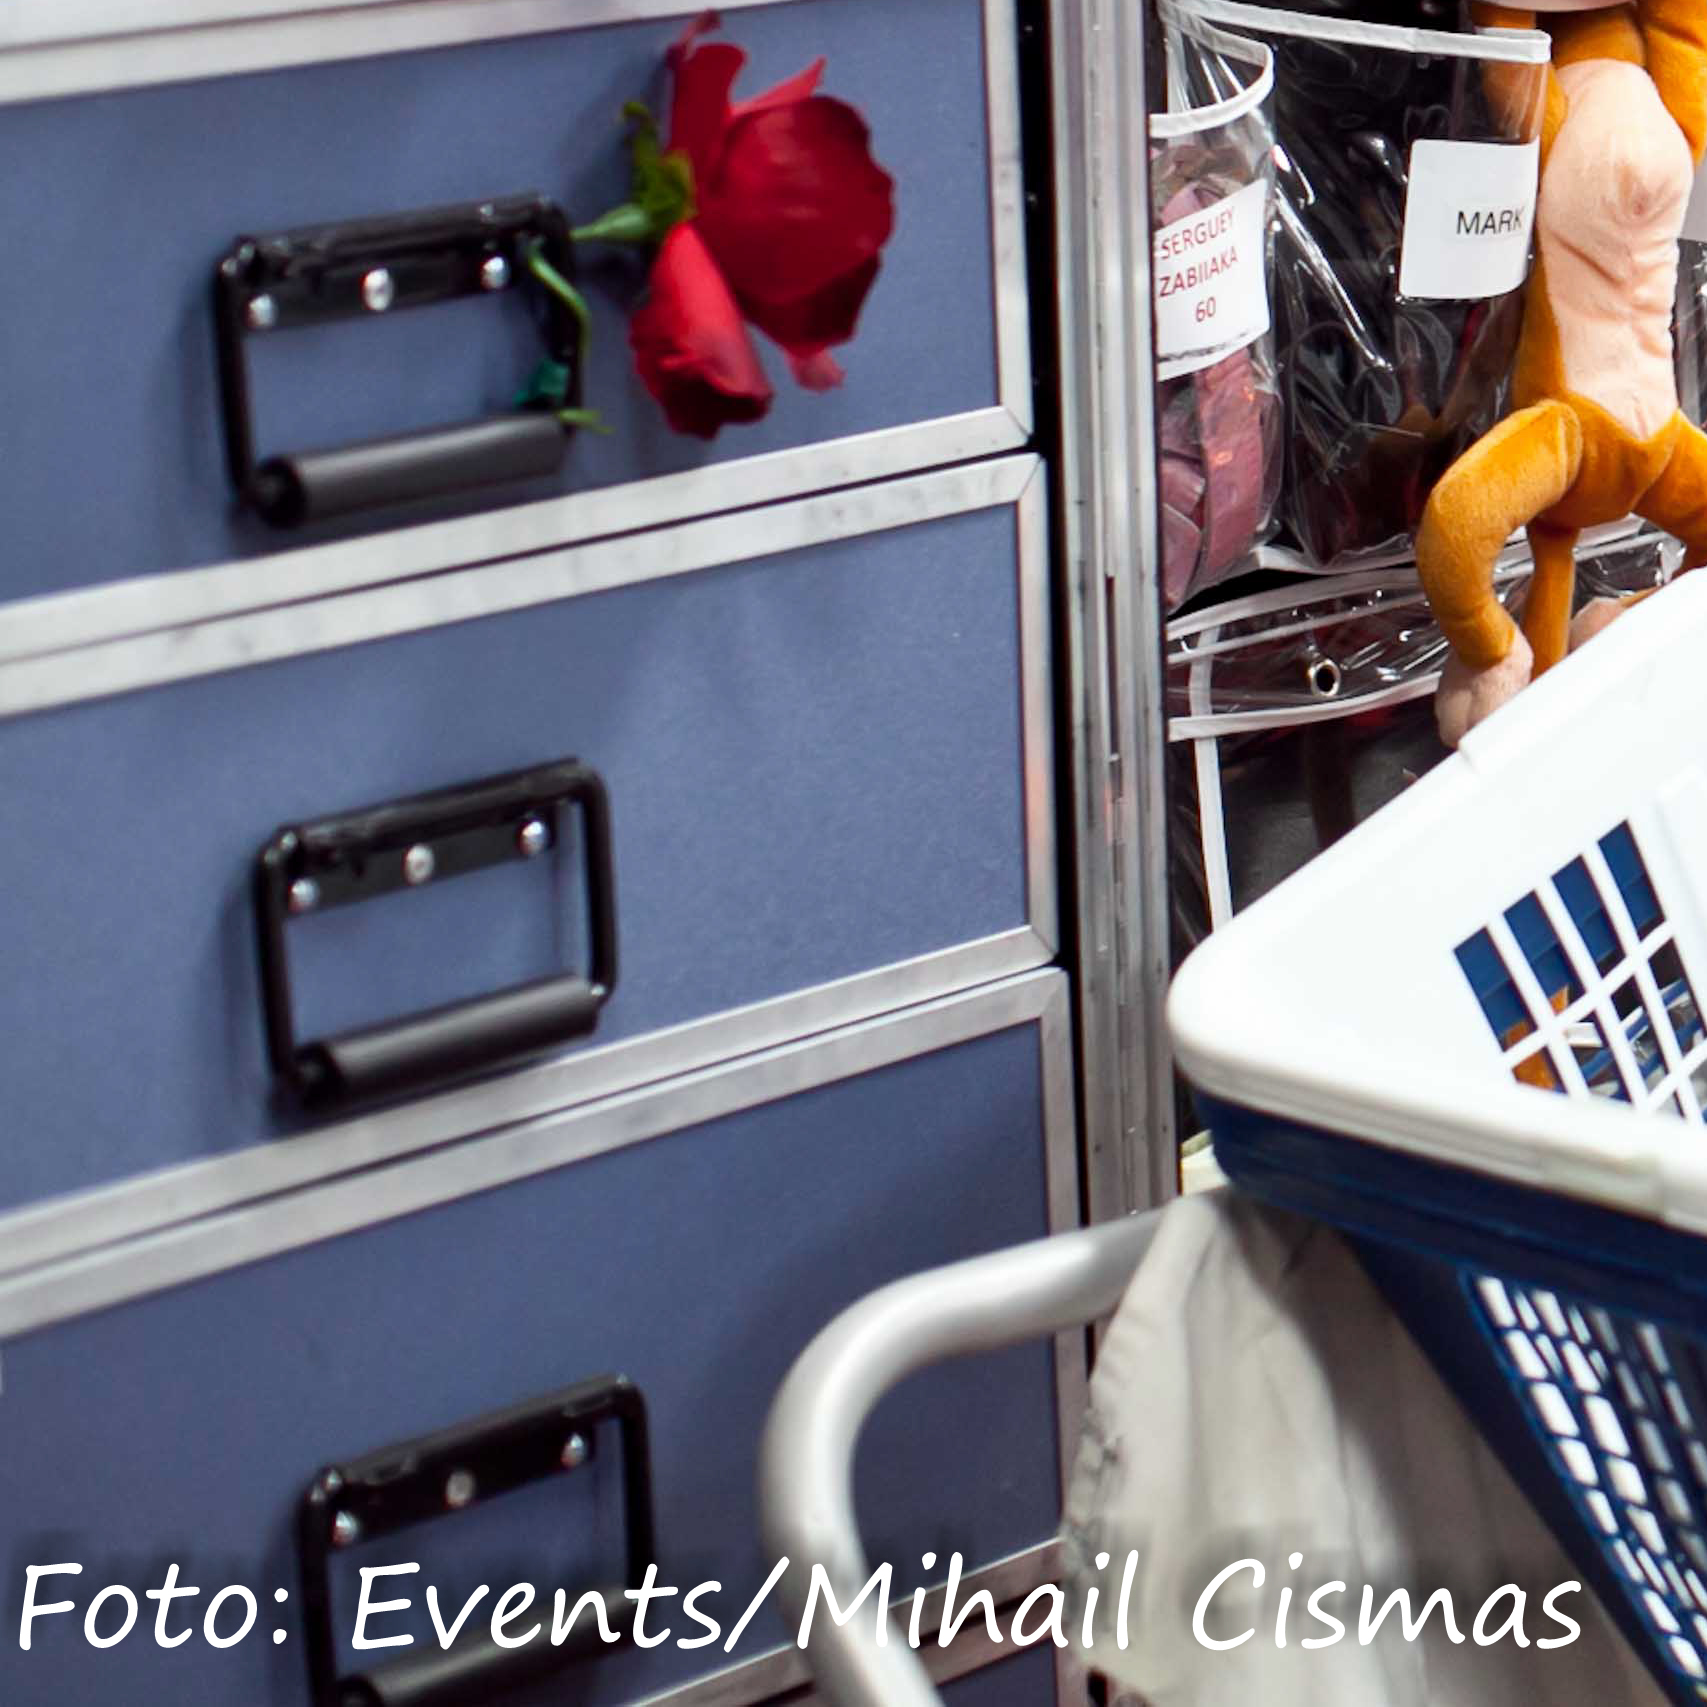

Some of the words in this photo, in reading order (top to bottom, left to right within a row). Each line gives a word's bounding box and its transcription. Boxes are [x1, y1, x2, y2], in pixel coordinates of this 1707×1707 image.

[1160, 205, 1236, 261] SERGUEY
[1456, 206, 1526, 236] MARK
[1159, 244, 1240, 298] ZABIIAKA
[1195, 295, 1217, 323] 60
